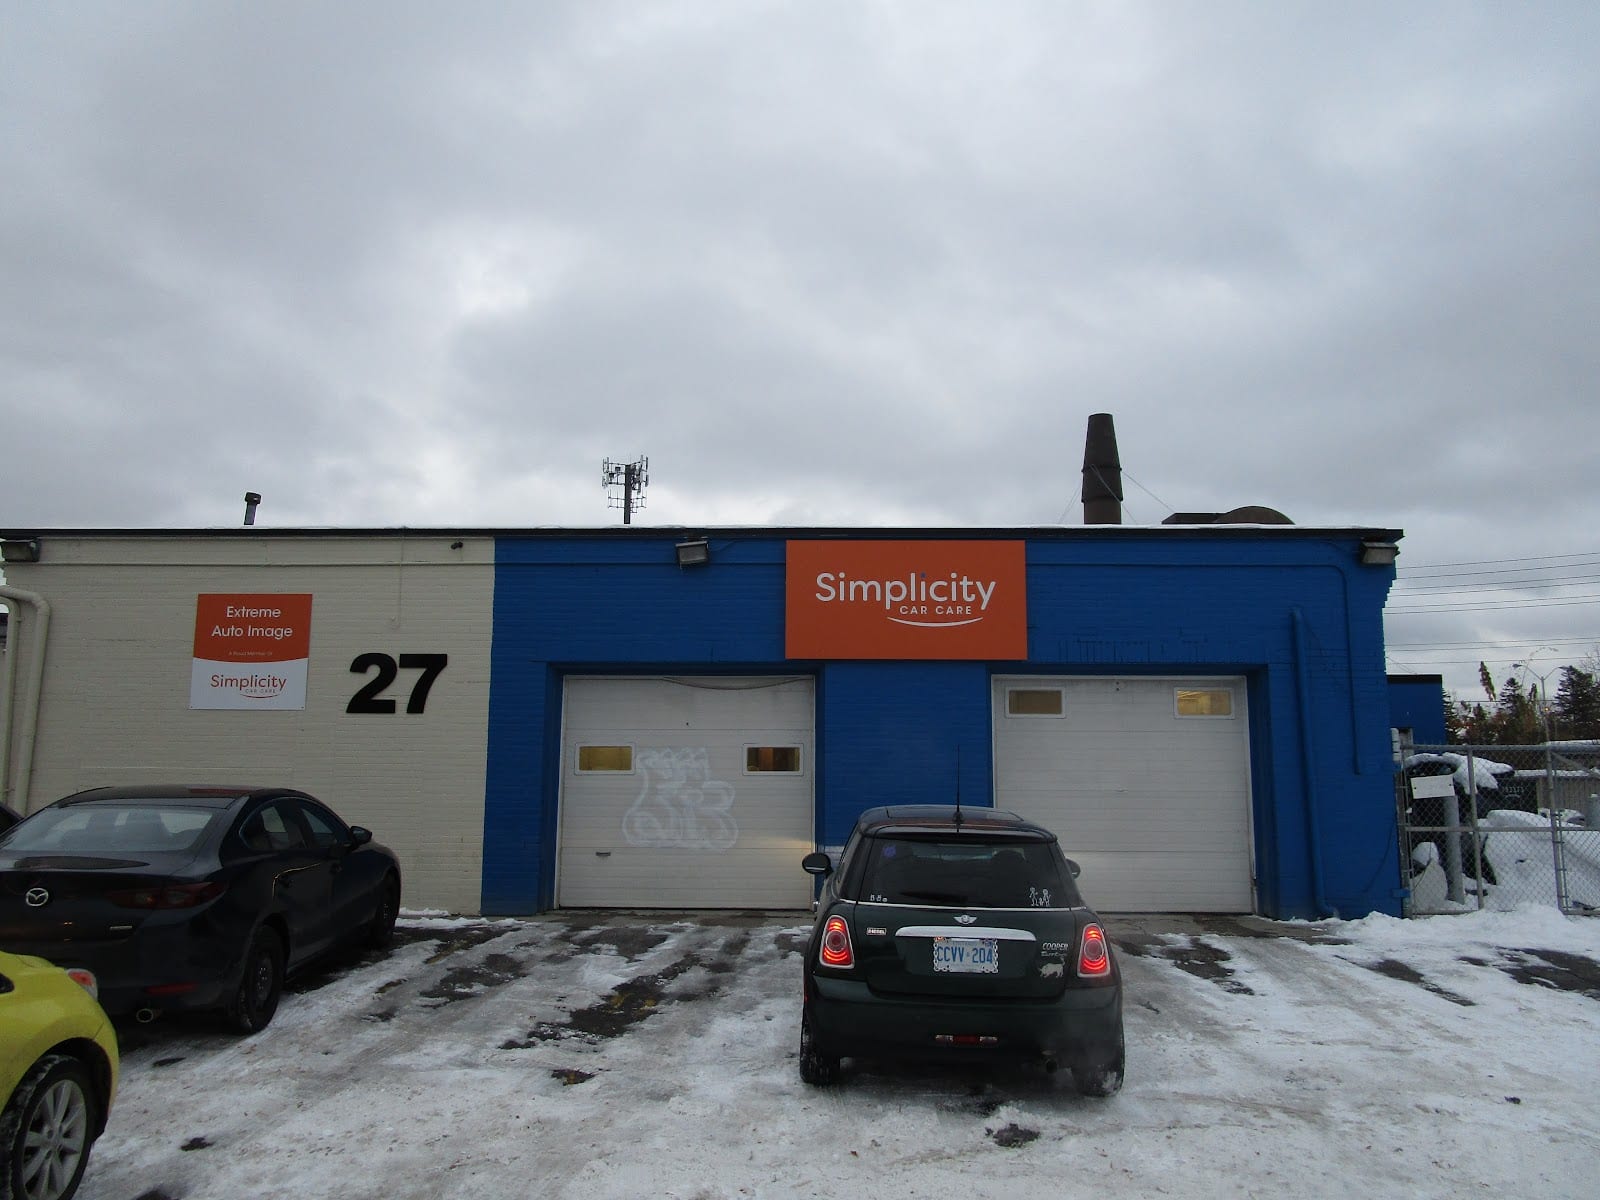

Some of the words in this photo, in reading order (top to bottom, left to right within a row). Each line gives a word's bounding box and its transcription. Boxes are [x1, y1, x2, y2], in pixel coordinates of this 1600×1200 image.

[815, 572, 996, 611] Simplicity
[226, 606, 281, 618] Extreme
[900, 605, 928, 615] CAR
[935, 605, 972, 615] CARE
[211, 625, 243, 637] Auto
[247, 625, 293, 640] Image
[210, 674, 287, 691] Simplicity
[346, 653, 448, 714] 27
[1042, 942, 1069, 951] COOPER
[972, 948, 993, 964] 204
